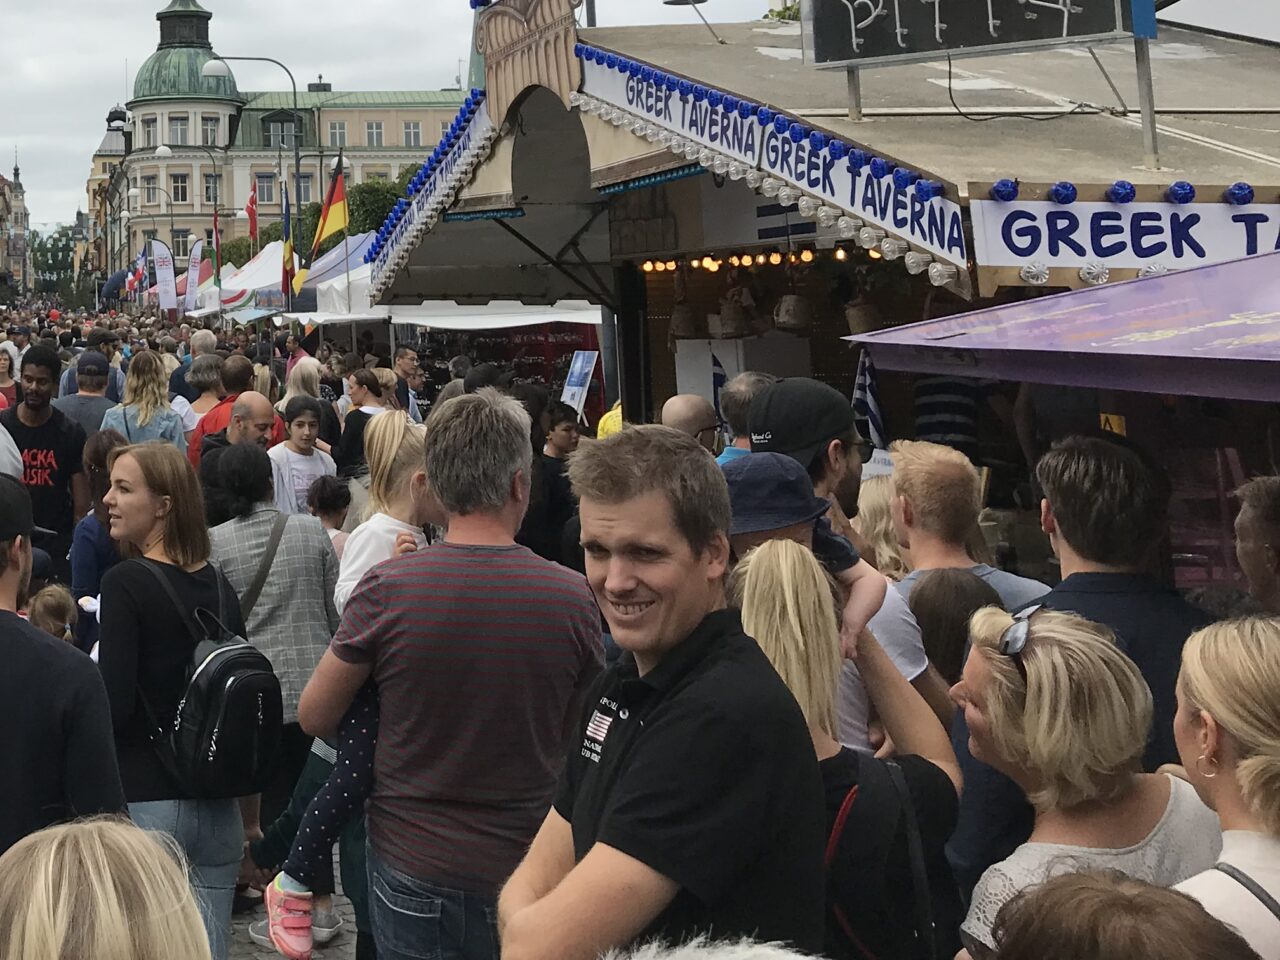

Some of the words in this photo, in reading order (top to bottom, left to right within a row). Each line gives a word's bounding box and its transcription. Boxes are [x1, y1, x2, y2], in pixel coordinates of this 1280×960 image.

[626, 73, 672, 123] GREEK
[679, 95, 756, 162] TAVERNA
[766, 130, 836, 198] GREEK
[846, 165, 965, 260] TAVERNA
[1001, 209, 1207, 259] GREEK
[1231, 212, 1280, 256] T
